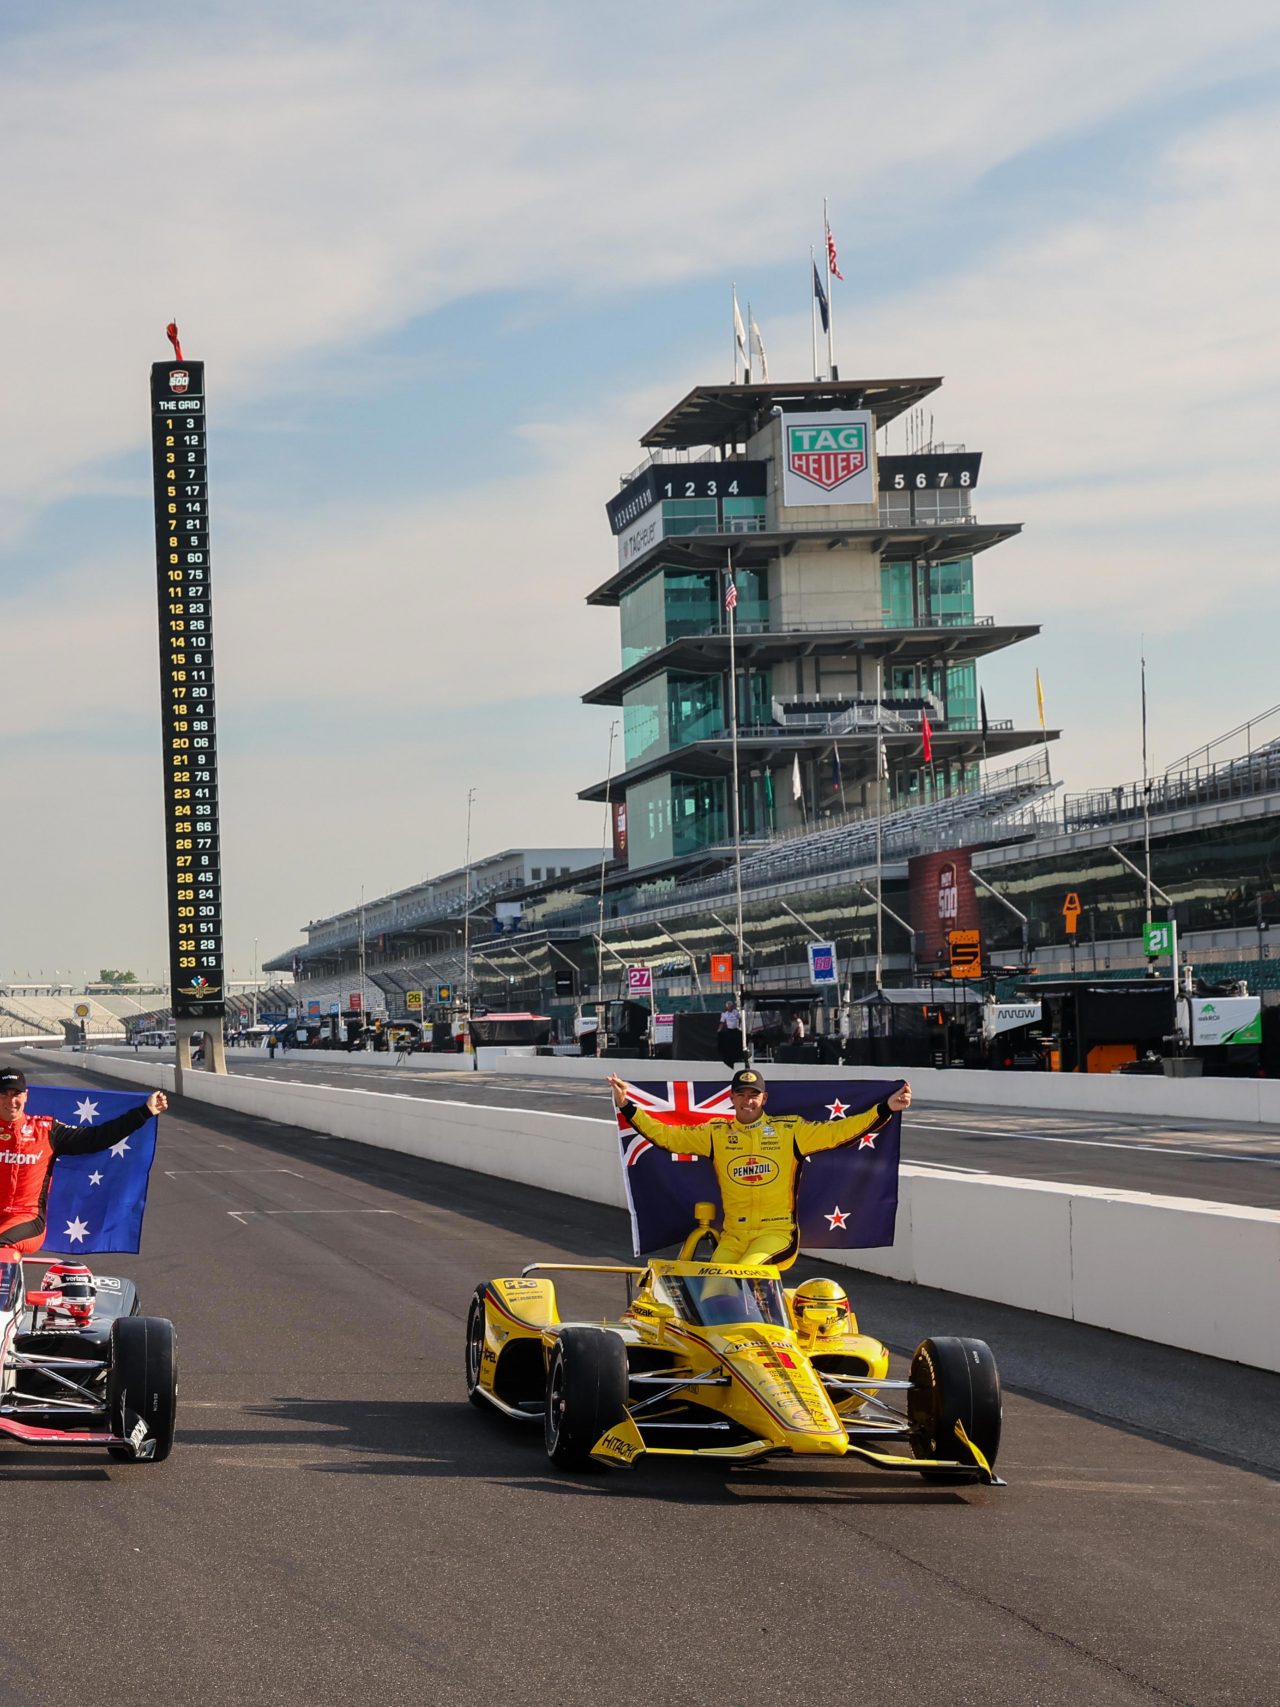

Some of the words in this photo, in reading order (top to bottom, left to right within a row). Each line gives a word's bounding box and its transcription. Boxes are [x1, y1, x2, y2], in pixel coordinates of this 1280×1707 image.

[170, 377, 189, 386] 500
[159, 401, 176, 410] THE
[178, 400, 200, 410] GRID
[166, 418, 172, 430] 1
[186, 418, 194, 428] 3
[166, 436, 174, 446] 2
[184, 436, 198, 444] 12
[795, 429, 858, 450] TAG
[166, 452, 174, 462] 3
[188, 452, 196, 462] 2
[166, 470, 176, 480] 4
[188, 468, 196, 478] 7
[794, 454, 861, 484] HEUER
[894, 474, 904, 488] 5
[916, 473, 926, 488] 6
[938, 472, 948, 488] 7
[960, 472, 970, 486] 8
[168, 486, 176, 496] 5
[186, 486, 200, 496] 17
[664, 482, 672, 498] 1
[685, 482, 695, 496] 2
[707, 481, 717, 496] 3
[728, 480, 739, 495] 4
[168, 502, 176, 514] 6
[186, 502, 200, 512] 14
[168, 520, 176, 530] 7
[186, 520, 200, 530] 21
[170, 536, 178, 548] 8
[190, 536, 198, 546] 5
[170, 554, 178, 564] 9
[188, 552, 202, 562] 60
[168, 570, 182, 580] 10
[188, 570, 202, 580] 75
[168, 586, 182, 598] 11
[188, 586, 202, 596] 27
[168, 604, 184, 614] 12
[190, 604, 204, 614] 23
[170, 620, 184, 630] 13
[190, 620, 204, 630] 26
[170, 636, 186, 648] 14
[190, 636, 206, 646] 10
[170, 654, 186, 664] 15
[194, 654, 202, 664] 6
[172, 670, 186, 682] 16
[192, 670, 206, 680] 11
[172, 688, 186, 698] 17
[192, 688, 208, 698] 20
[172, 704, 188, 714] 18
[196, 704, 204, 714] 4
[174, 722, 188, 732] 19
[192, 720, 208, 730] 98
[172, 738, 190, 748] 20
[194, 738, 208, 748] 06
[174, 754, 188, 766] 21
[198, 754, 206, 764] 9
[174, 772, 190, 782] 22
[194, 772, 210, 782] 78
[174, 788, 190, 800] 23
[194, 788, 208, 798] 41
[174, 804, 192, 816] 24
[196, 804, 210, 814] 33
[176, 822, 192, 832] 25
[196, 822, 212, 832] 66
[176, 838, 192, 850] 26
[196, 838, 212, 848] 77
[176, 856, 192, 866] 27
[202, 856, 208, 866] 8
[176, 872, 194, 884] 28
[198, 872, 214, 882] 45
[178, 890, 194, 900] 29
[198, 888, 214, 900] 24
[938, 887, 958, 918] 500
[178, 906, 194, 916] 30
[200, 906, 214, 916] 30
[178, 924, 194, 934] 31
[200, 922, 214, 932] 51
[178, 940, 196, 950] 32
[200, 940, 216, 950] 28
[1149, 928, 1168, 951] 21
[180, 956, 196, 968] 33
[202, 956, 216, 966] 15
[630, 971, 649, 986] 27
[408, 994, 421, 1004] 26
[733, 1164, 772, 1177] PENNZOIL
[504, 1280, 537, 1289] PPG
[602, 1434, 638, 1458] HITACHI
